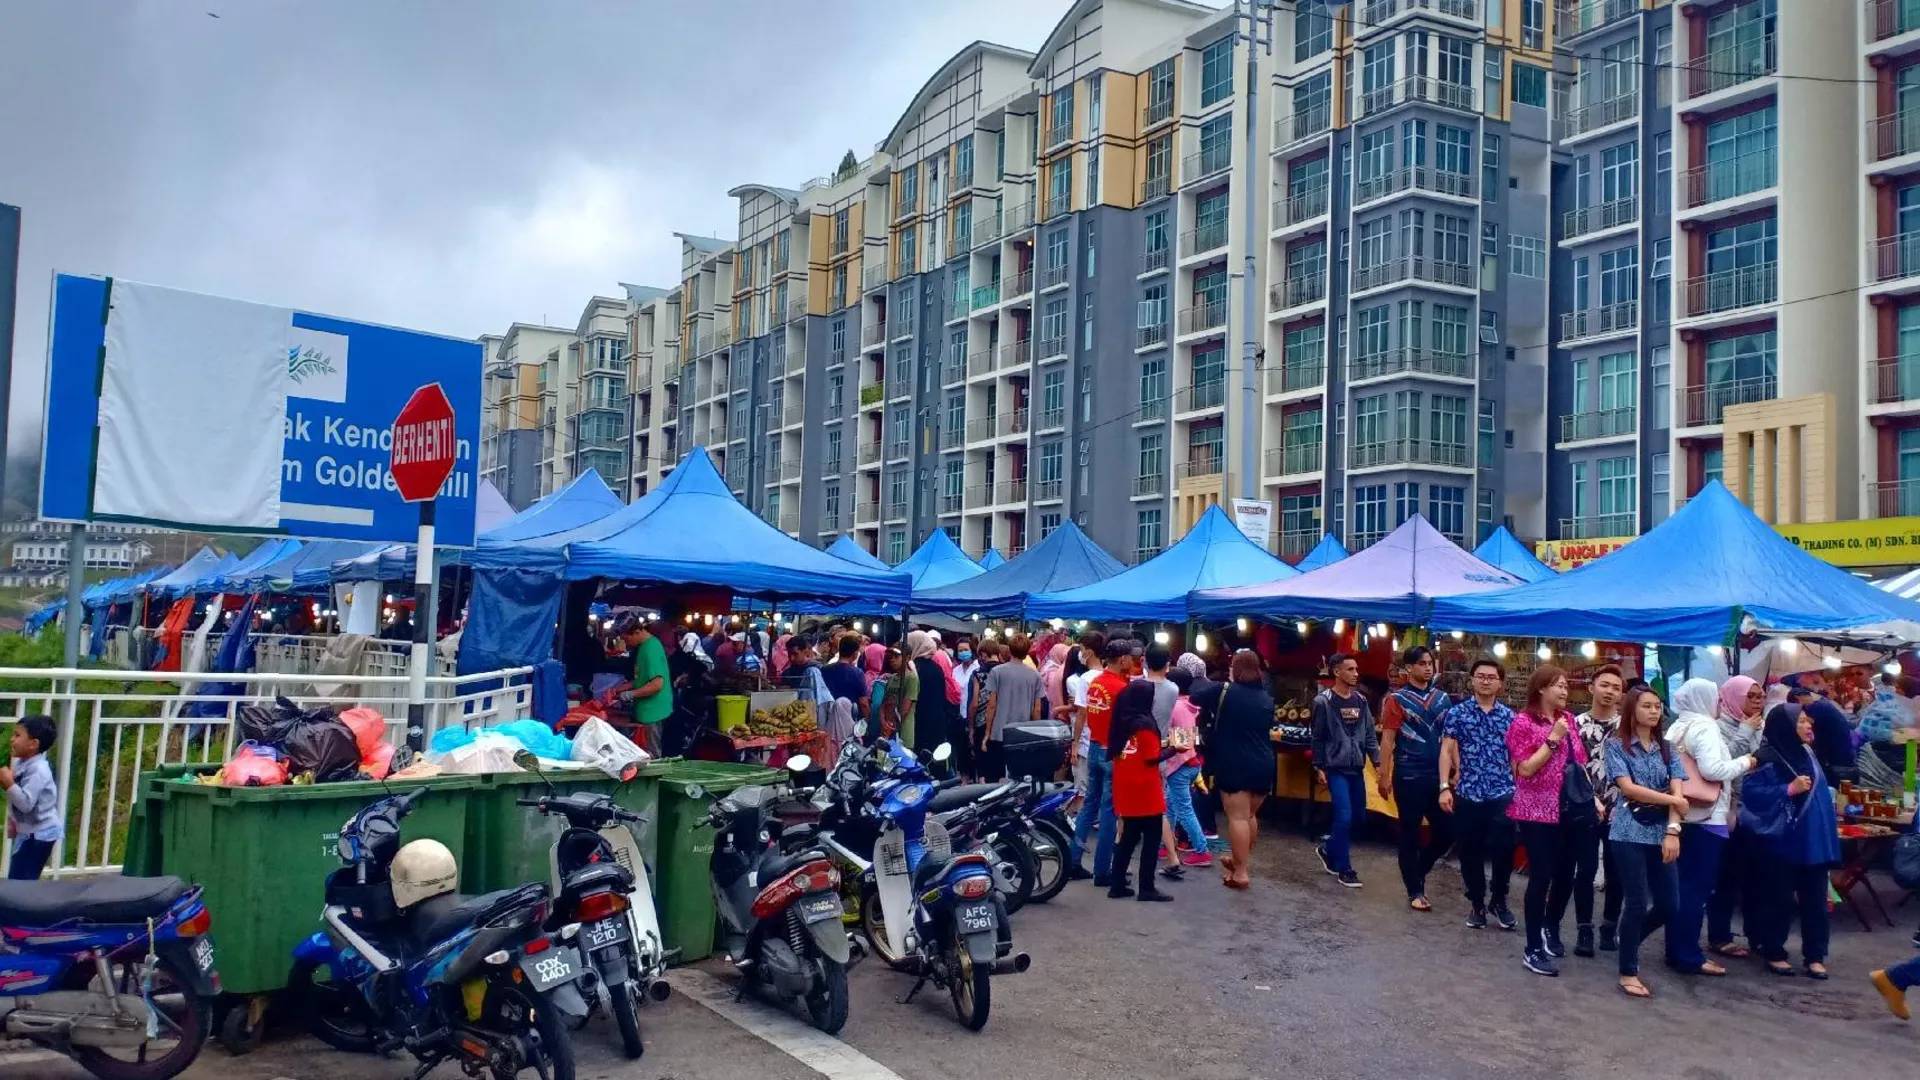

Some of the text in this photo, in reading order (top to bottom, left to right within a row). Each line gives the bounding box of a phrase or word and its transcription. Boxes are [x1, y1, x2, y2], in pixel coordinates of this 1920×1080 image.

[281, 412, 312, 442] ak
[393, 417, 452, 466] BERHENTI
[315, 455, 398, 491] Golde
[439, 471, 469, 498] ill
[1802, 539, 1845, 551] TRADING
[1847, 537, 1862, 549] CO.
[1865, 536, 1882, 550] (M)
[1885, 534, 1908, 547] SDN.
[1560, 543, 1609, 560] UNCLE
[965, 906, 987, 918] AFC
[590, 917, 614, 934] JHE
[963, 916, 991, 929] 7961
[592, 928, 617, 945] 1210
[541, 963, 571, 983] 4407
